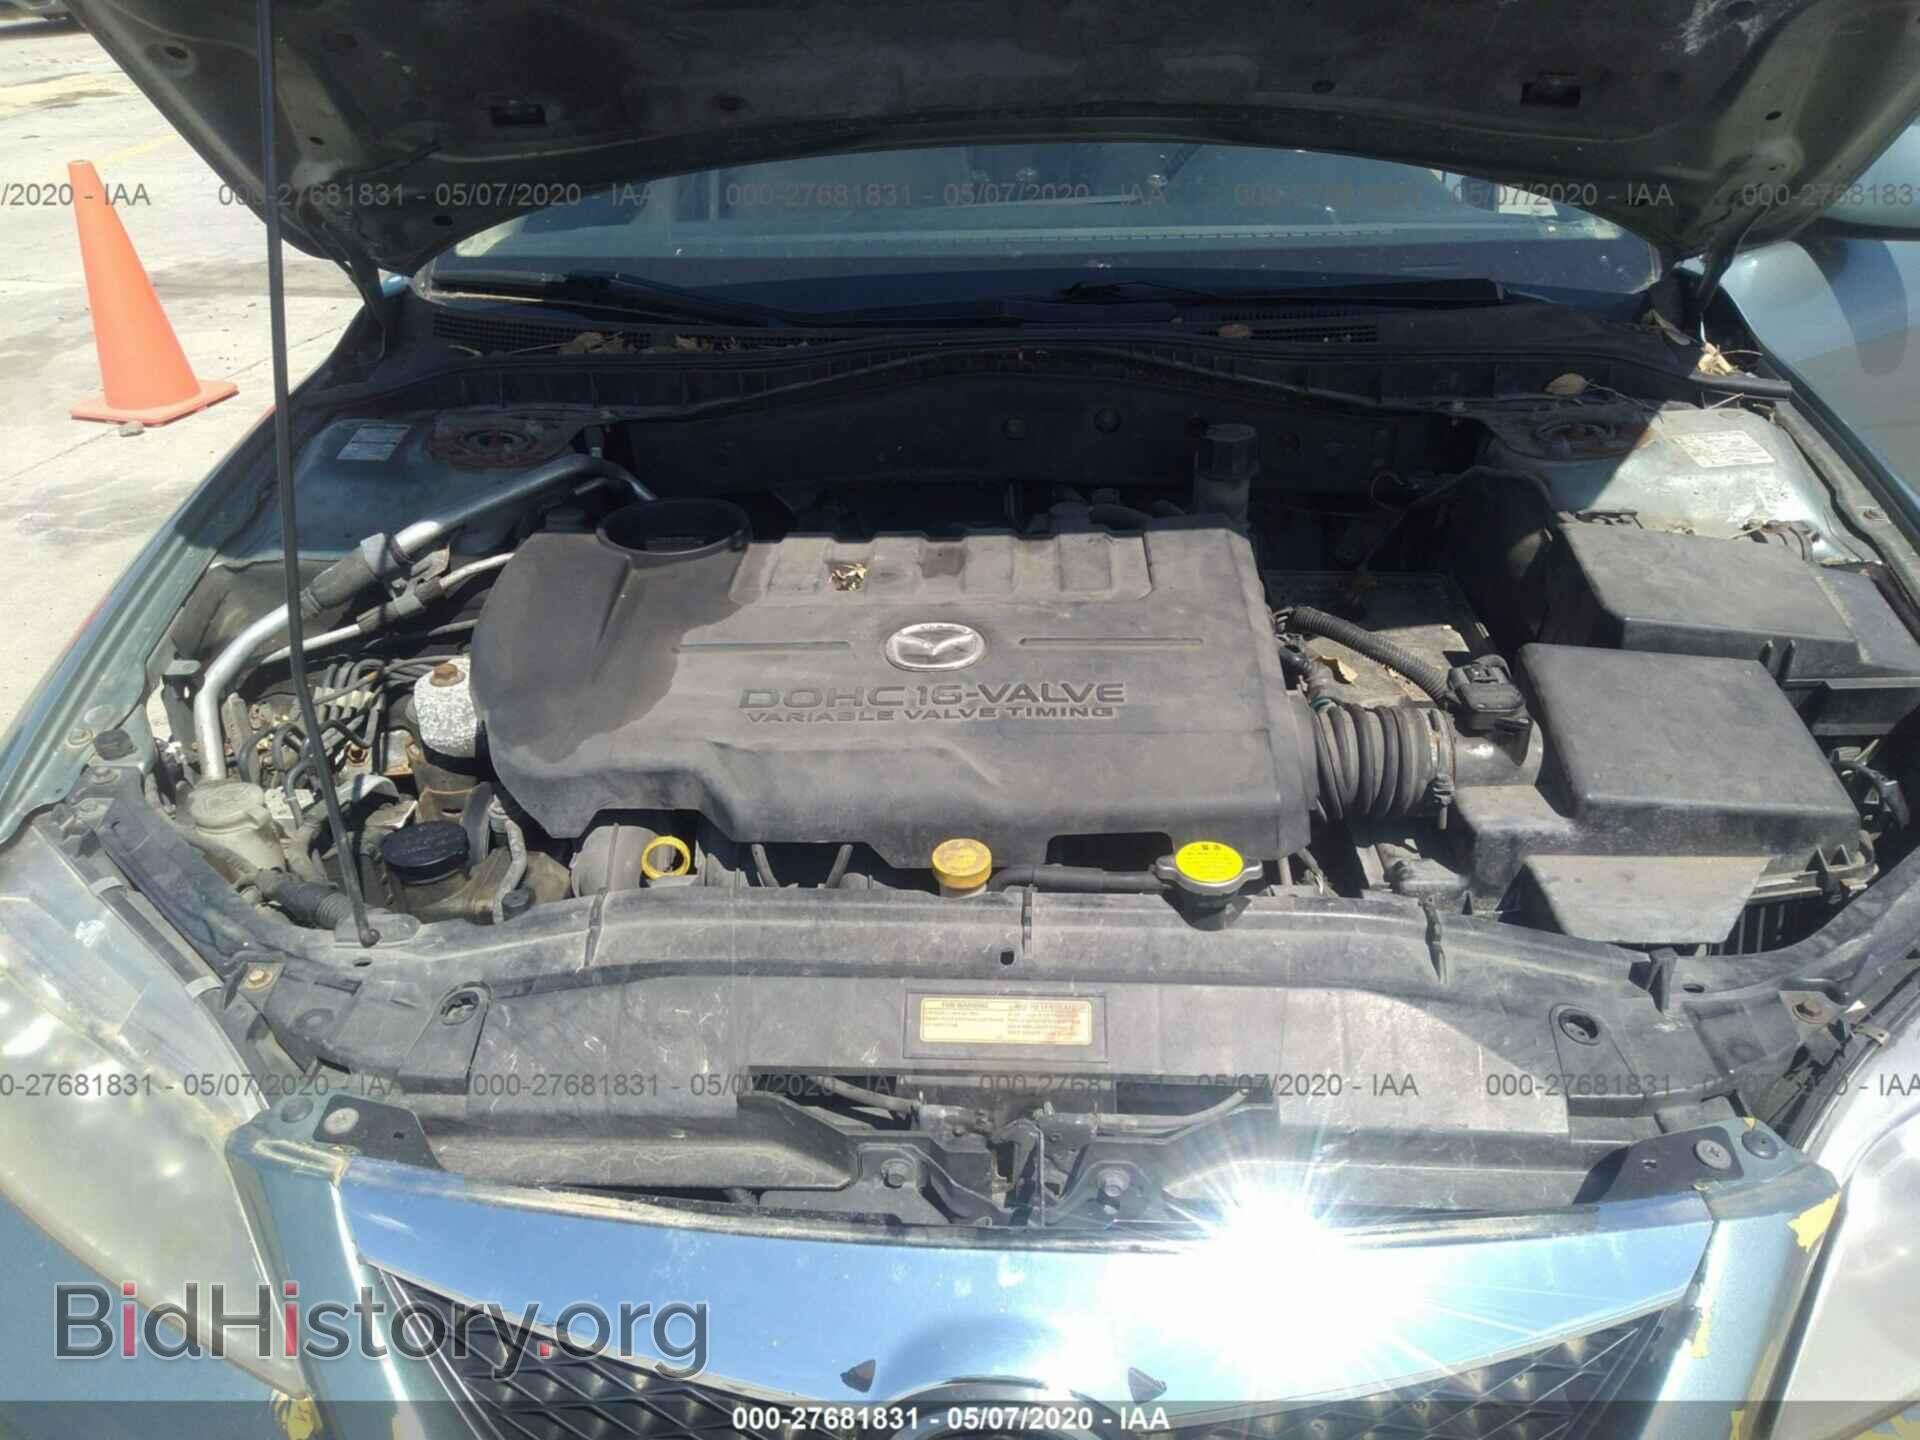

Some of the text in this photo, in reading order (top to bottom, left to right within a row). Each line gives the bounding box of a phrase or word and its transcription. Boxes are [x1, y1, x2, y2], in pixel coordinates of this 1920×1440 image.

[739, 685, 906, 710] DOHC
[745, 705, 1116, 723] VARIABLE VALVE TIMING
